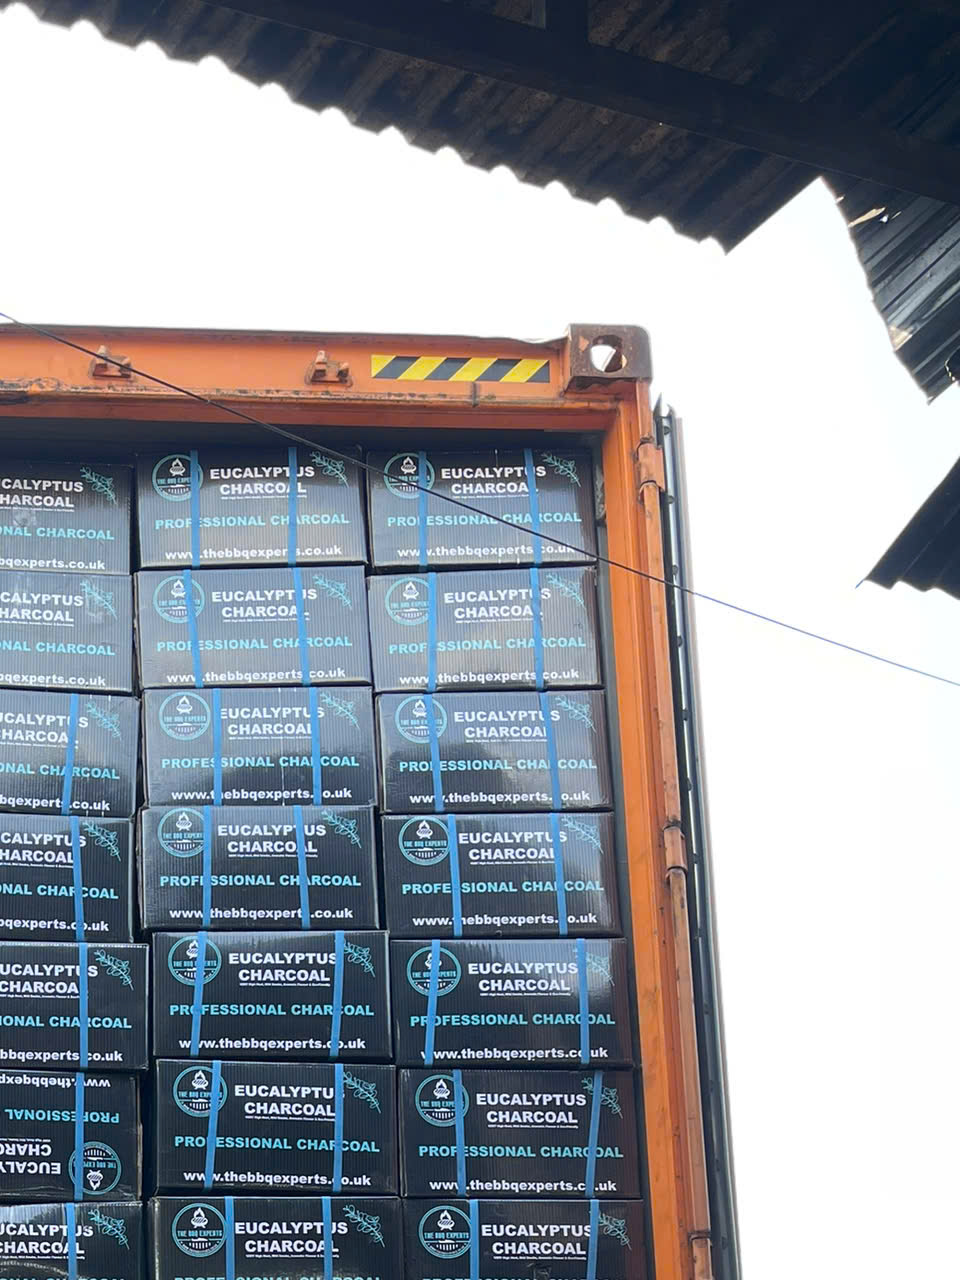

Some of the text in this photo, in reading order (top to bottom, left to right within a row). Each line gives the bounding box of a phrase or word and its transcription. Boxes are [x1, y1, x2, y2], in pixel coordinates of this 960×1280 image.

[440, 465, 546, 479] EUCALYPTS
[219, 481, 307, 495] CHARCOL
[450, 481, 538, 494] CHARCOA
[154, 515, 266, 529] PROFSSIONAL
[36, 526, 115, 540] CHARCOAL
[164, 544, 342, 560] ww.thebbqexpers.co.uk
[443, 587, 551, 603] EUCALYPTS
[453, 604, 543, 619] CHARCOA
[35, 641, 115, 655] CHARCOAL
[388, 639, 502, 654] PROFSSIONAL
[463, 725, 553, 738] CHARCOA
[160, 755, 360, 769] PROFESIONAL CHACOAL
[516, 758, 597, 770] CHACOAL
[39, 764, 120, 779] CHRCOAL
[409, 789, 591, 804] ww.thebbqexperts.o.uk
[217, 824, 326, 836] EUCALYPUS
[227, 840, 318, 853] CHARCOL
[279, 874, 361, 886] CHRCOAL
[401, 880, 604, 894] PROFESIONAL CHACOAL
[238, 969, 330, 981] CHARCOAL
[467, 961, 579, 975] EUCALYPTUS
[478, 978, 571, 991] CHARCOAL
[169, 1004, 374, 1015] PRFESSIONAL CHAROAL
[420, 1046, 608, 1061] ww.thebbqexperts.cuk
[234, 1084, 345, 1099] EUCALYPTU
[475, 1093, 586, 1106] EUCALYPTUS
[4, 1109, 121, 1124] PROFSSIONAL
[486, 1110, 578, 1123] CHARCOAL
[174, 1135, 292, 1149] PROESSIONAL
[418, 1145, 536, 1157] PROFSSIONAL
[428, 1179, 617, 1193] ww.thebbqexperts.c.uk
[491, 1241, 586, 1255] CHARCOAL
